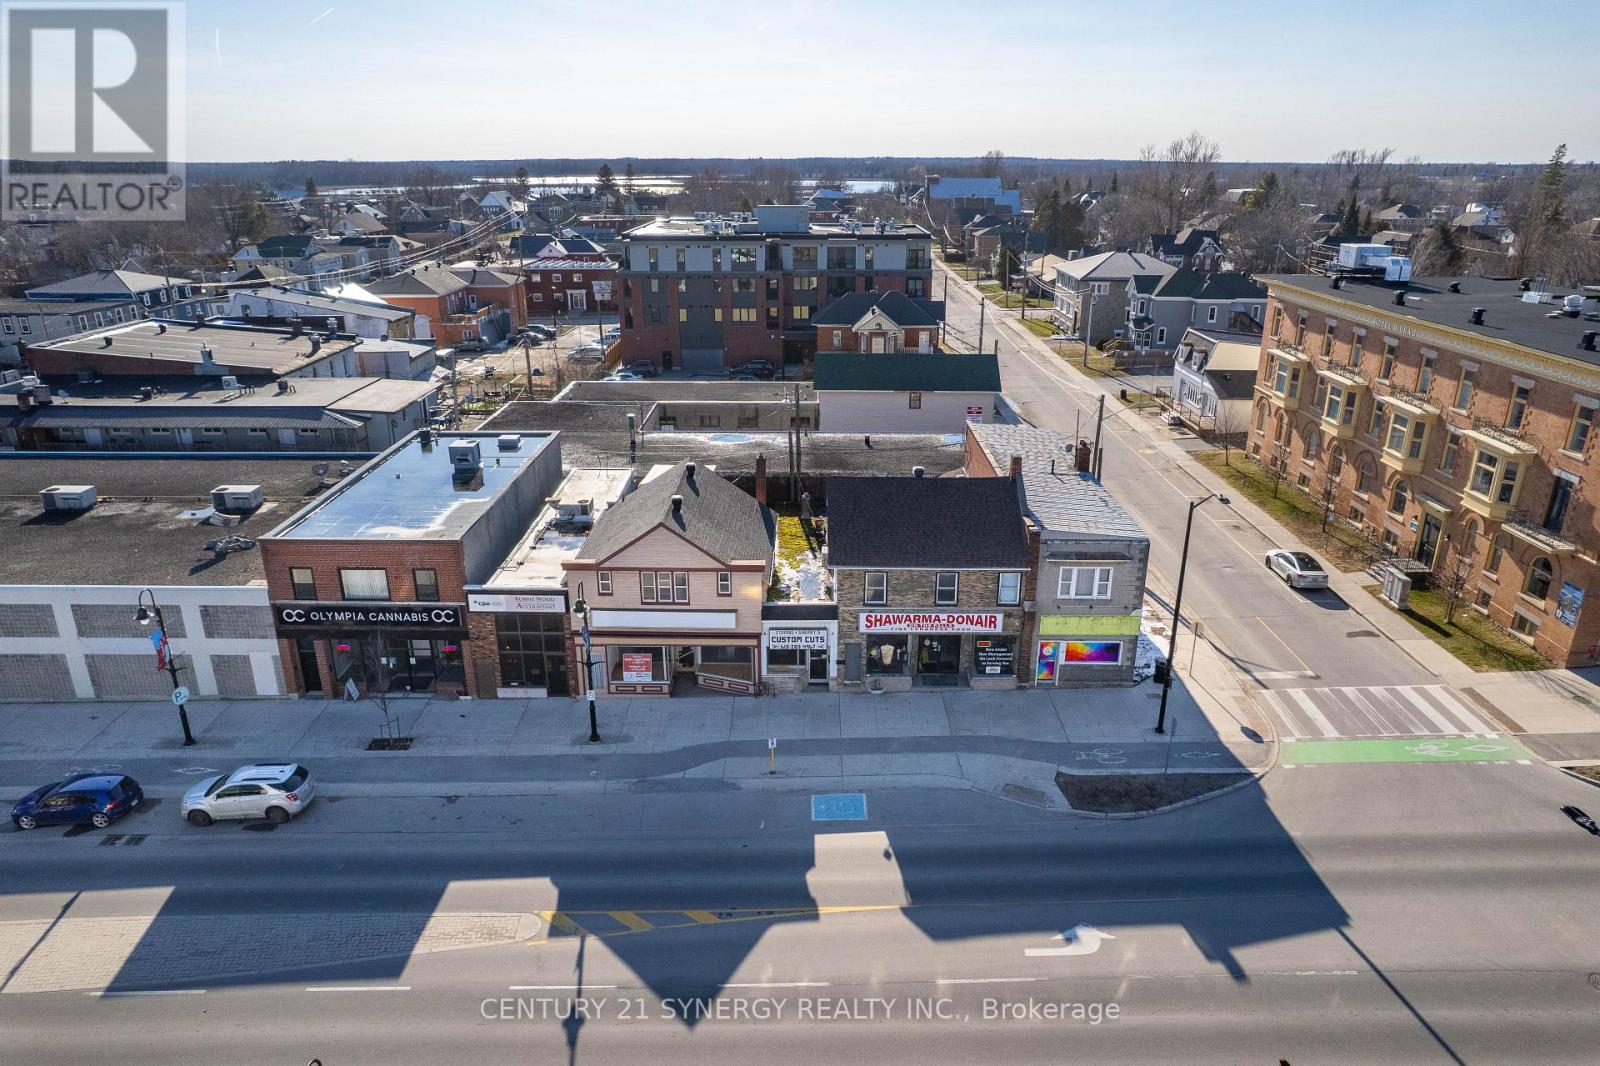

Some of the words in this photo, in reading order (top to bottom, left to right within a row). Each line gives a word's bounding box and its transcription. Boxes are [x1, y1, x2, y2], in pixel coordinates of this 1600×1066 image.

[310, 611, 366, 621] OLYMPIA
[369, 612, 429, 622] CANNABIS
[864, 614, 998, 629] SHAWARMA-DONAIR
